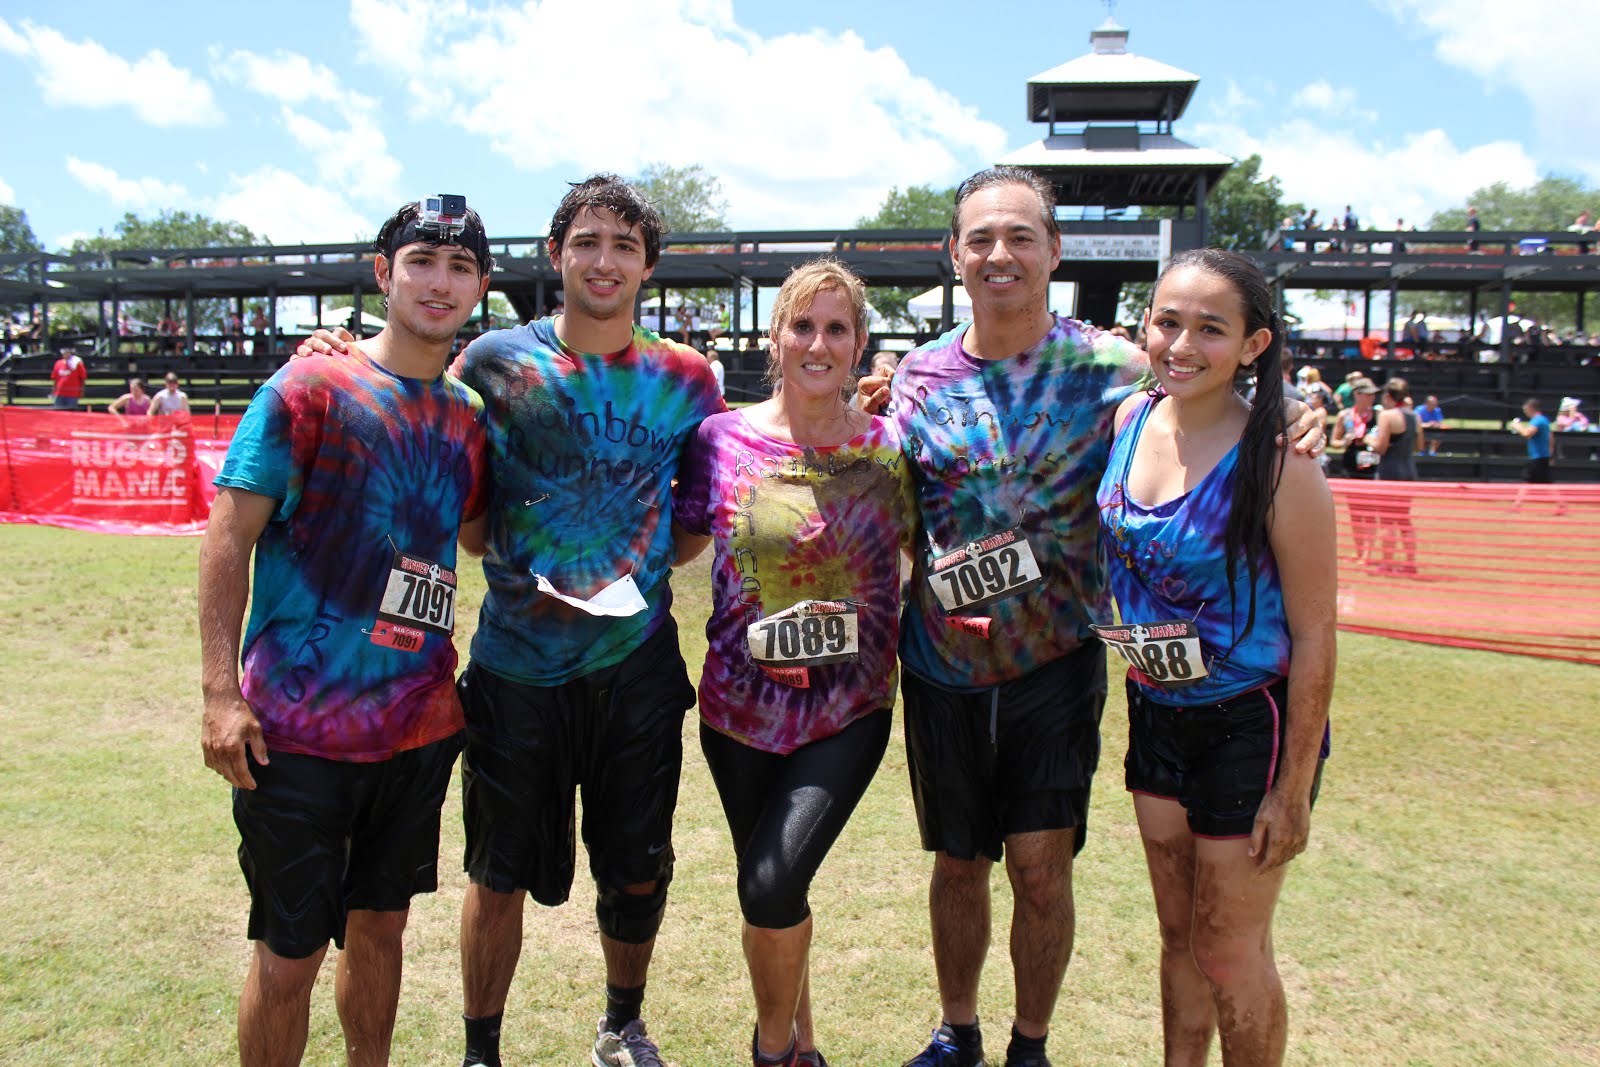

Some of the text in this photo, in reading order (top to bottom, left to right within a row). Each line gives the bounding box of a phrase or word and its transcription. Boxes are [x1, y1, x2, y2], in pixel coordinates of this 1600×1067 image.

[1060, 249, 1092, 258] FFICIAL
[1096, 249, 1120, 258] RACE
[734, 448, 903, 481] Rainbow
[73, 467, 187, 498] MANIAC
[941, 547, 1028, 607] 7092
[397, 574, 453, 627] 7091
[391, 632, 418, 650] 7091
[759, 615, 846, 660] 7089
